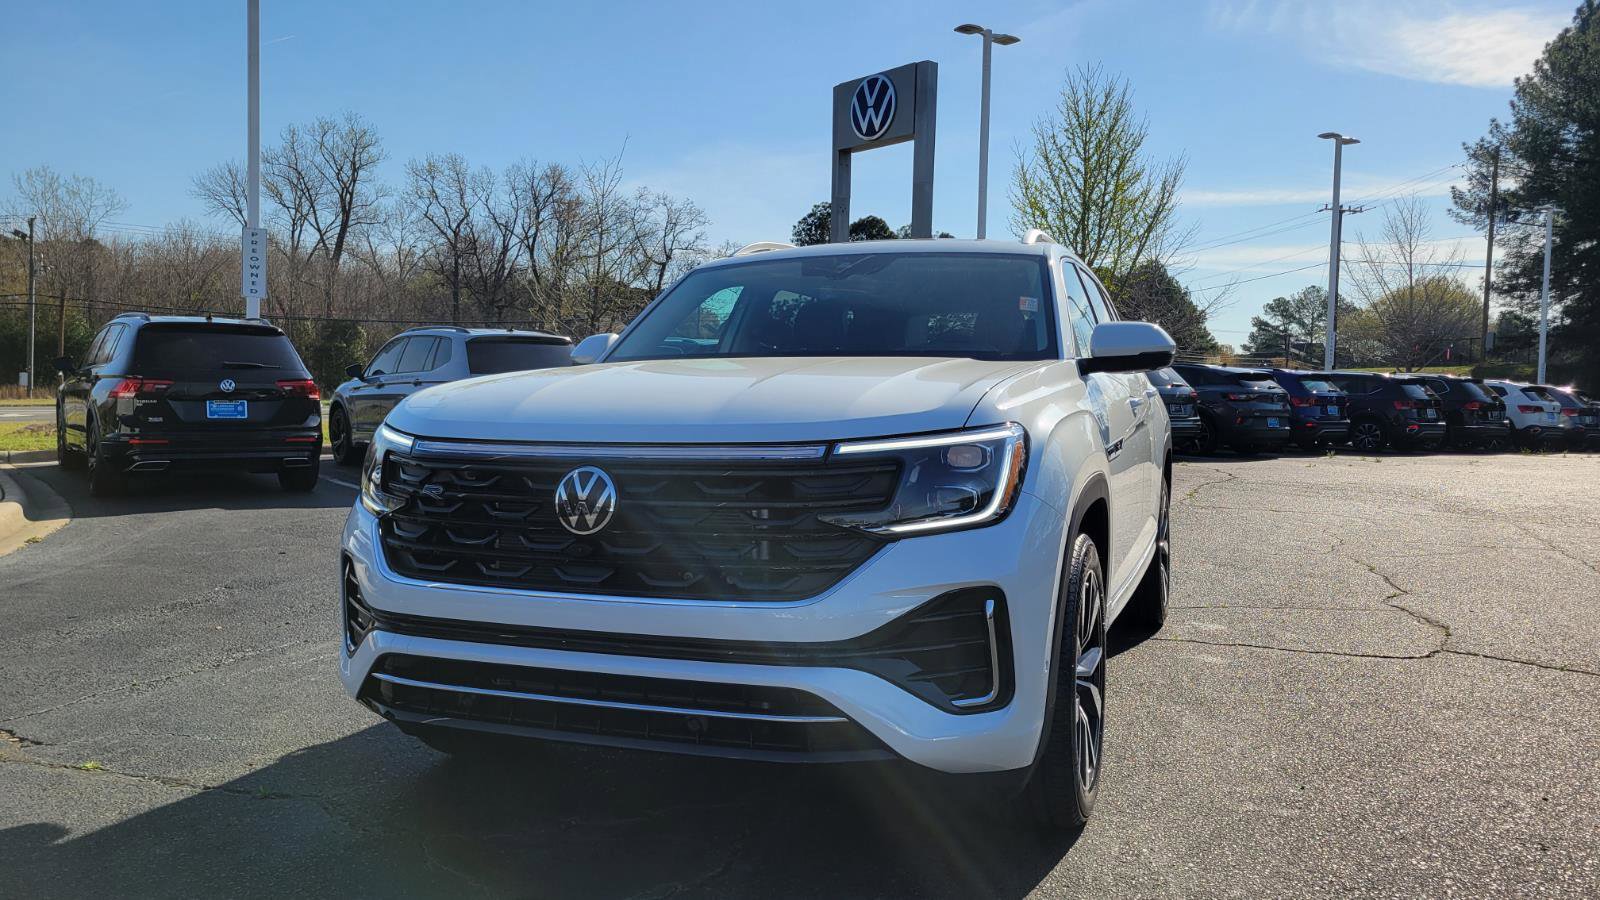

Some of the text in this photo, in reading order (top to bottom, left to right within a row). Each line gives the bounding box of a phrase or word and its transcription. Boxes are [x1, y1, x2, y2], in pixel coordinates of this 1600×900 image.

[851, 75, 896, 140] VW
[220, 379, 236, 393] VW
[555, 466, 617, 535] VW
